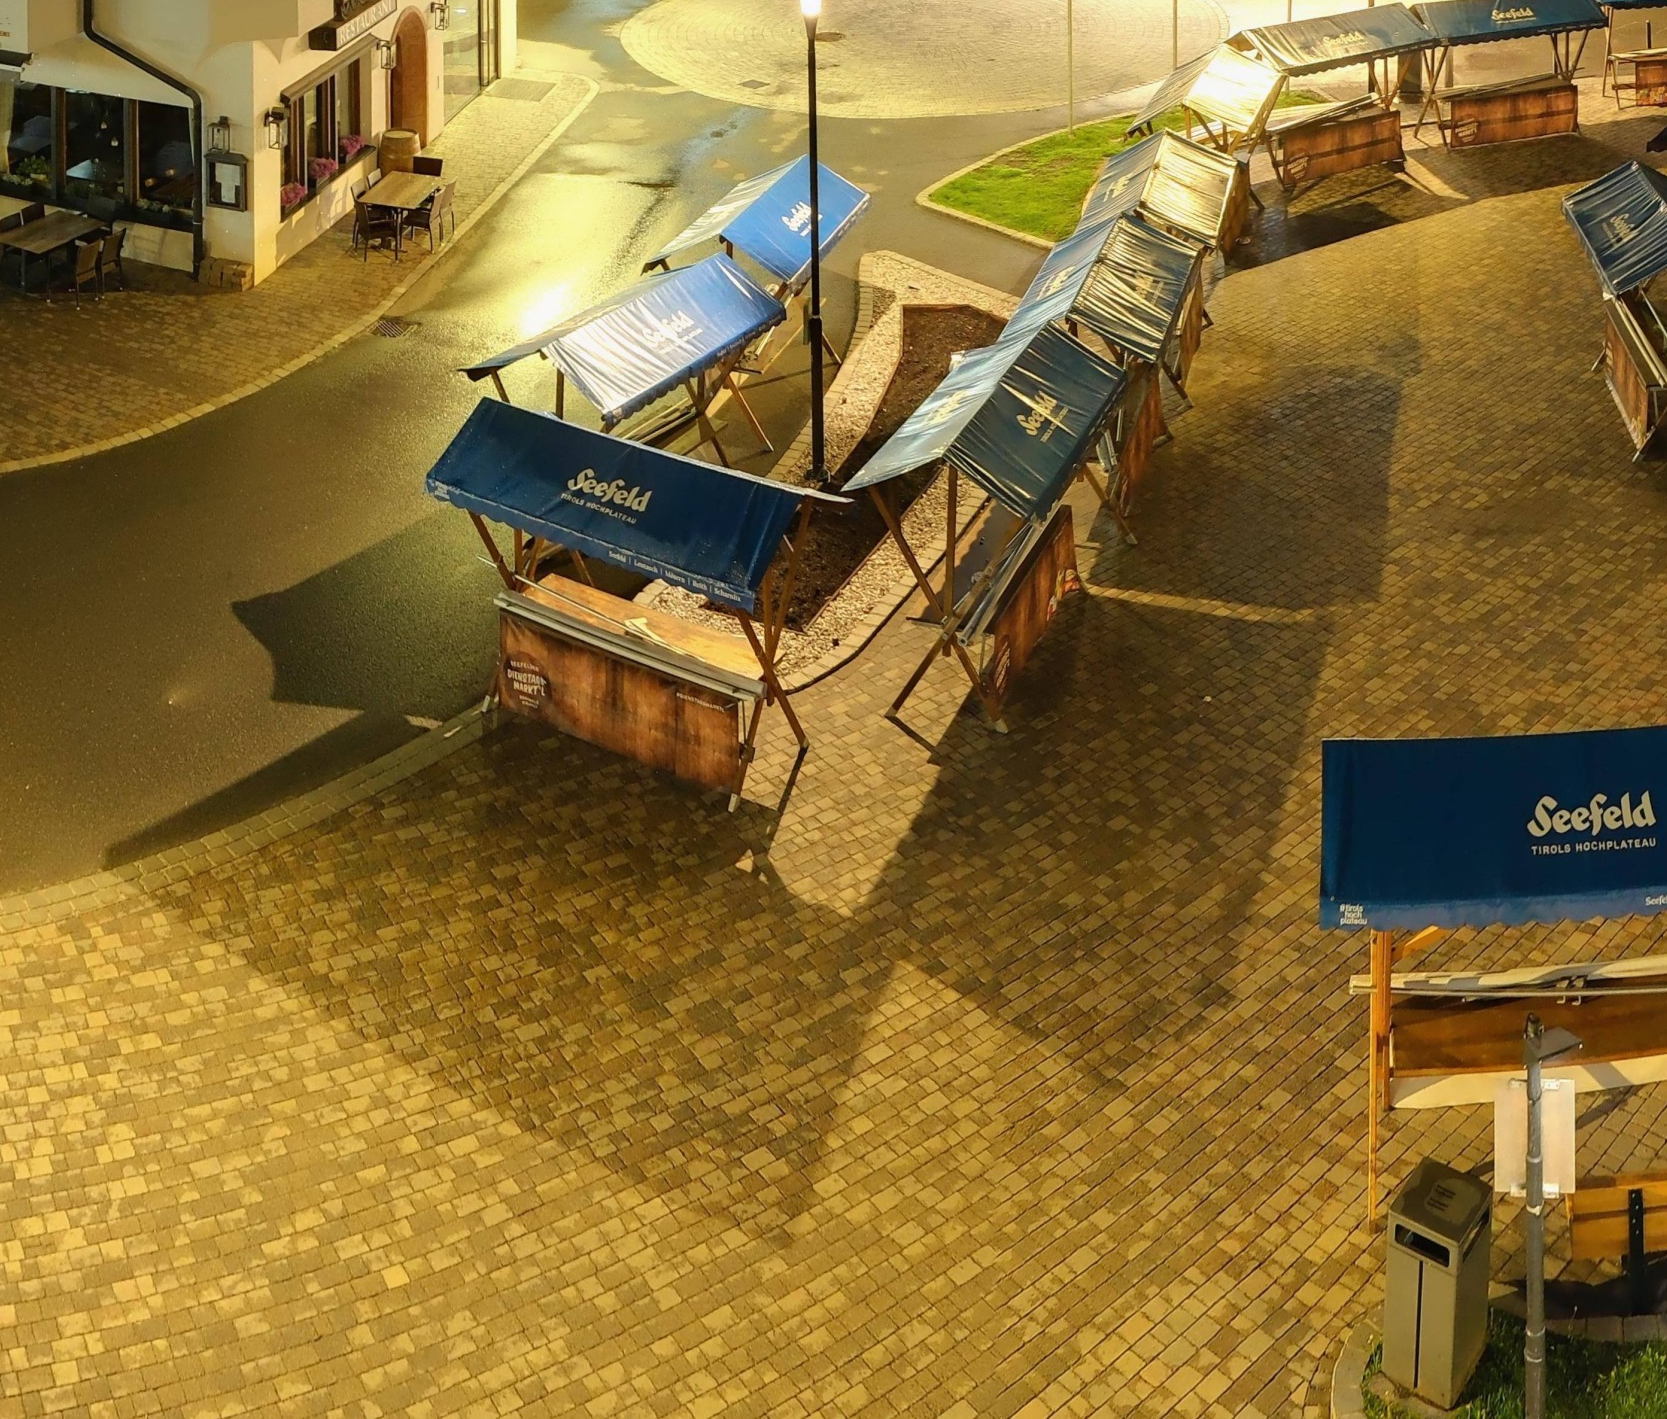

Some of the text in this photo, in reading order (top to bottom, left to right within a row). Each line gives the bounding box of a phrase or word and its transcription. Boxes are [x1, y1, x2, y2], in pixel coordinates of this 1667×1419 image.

[1492, 6, 1535, 22] Seefeld
[567, 468, 653, 514] Seefeld
[585, 500, 637, 525] HOCHPLATEAU
[1527, 790, 1657, 838] Seefeld
[1531, 836, 1658, 856] TIROLS HOCHPLATEAU
